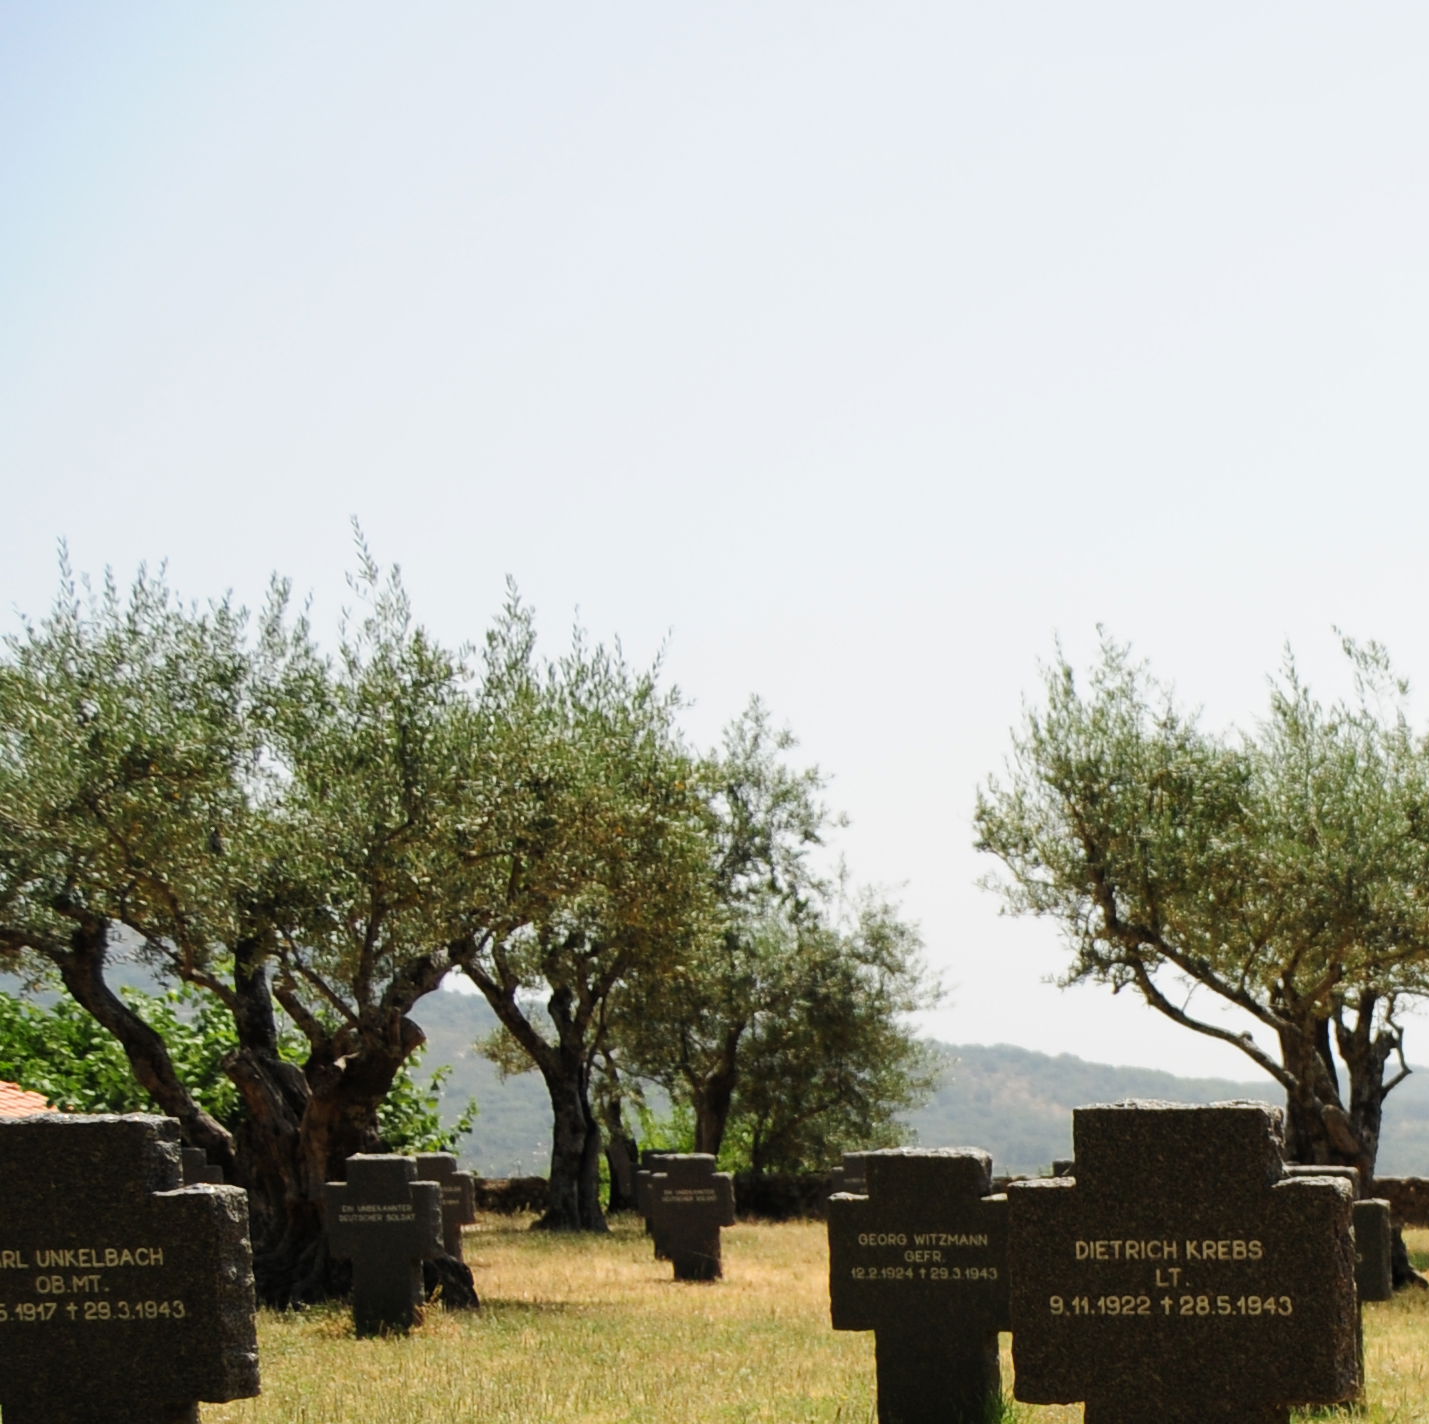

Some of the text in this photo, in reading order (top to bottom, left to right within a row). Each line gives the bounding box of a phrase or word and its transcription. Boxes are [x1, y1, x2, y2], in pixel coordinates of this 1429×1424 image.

[858, 1233, 988, 1246] GEORG WITZMANN
[36, 1248, 164, 1269] UNKELBACH
[904, 1250, 946, 1262] GEFR.
[1075, 1240, 1263, 1260] DIETRICH KREBS
[851, 1267, 913, 1280] 12.2.1924
[930, 1267, 998, 1280] 29.3.1943
[1155, 1267, 1191, 1287] LT.
[36, 1275, 110, 1294] OB.MT.
[83, 1300, 187, 1320] 29.3.1943
[1049, 1295, 1151, 1316] 9.11.1922
[1178, 1295, 1293, 1316] 28.5.1943
